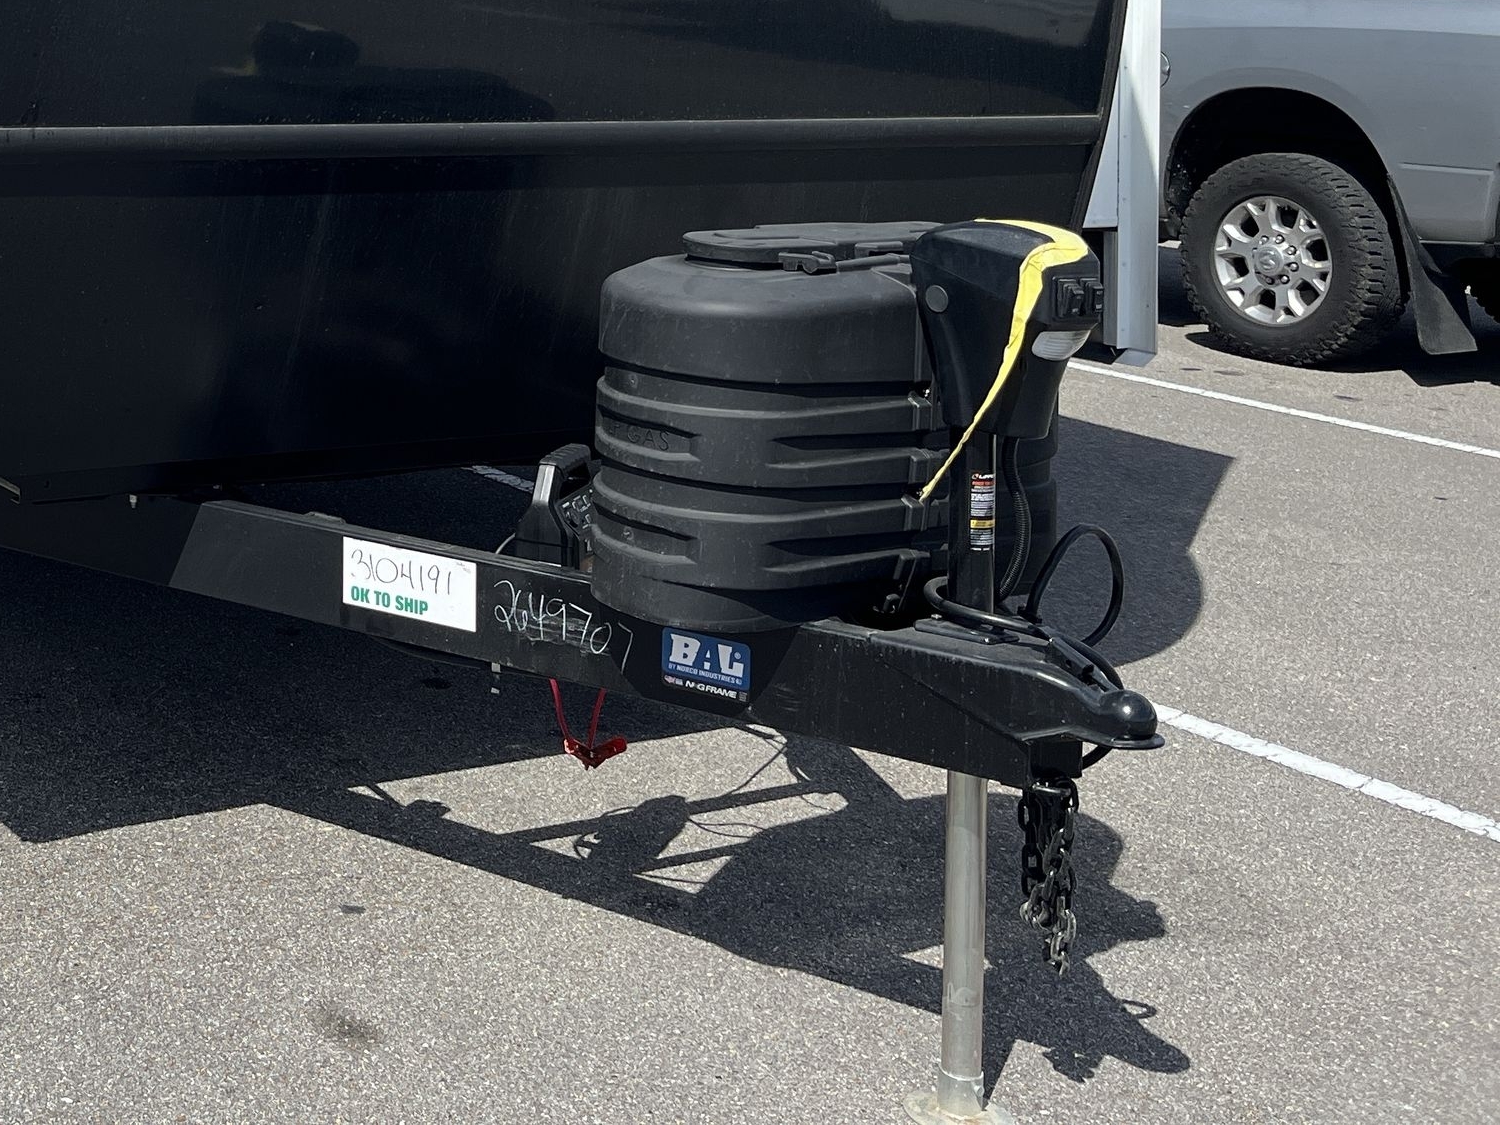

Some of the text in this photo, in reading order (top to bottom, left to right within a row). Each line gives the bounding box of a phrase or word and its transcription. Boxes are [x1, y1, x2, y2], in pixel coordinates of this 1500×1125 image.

[351, 549, 451, 595] 3104191
[350, 585, 429, 615] OK TO SHIP
[669, 633, 744, 678] BAL
[668, 662, 736, 685] BY NORCO INDUSTRIES
[685, 680, 737, 699] NGFRAME
